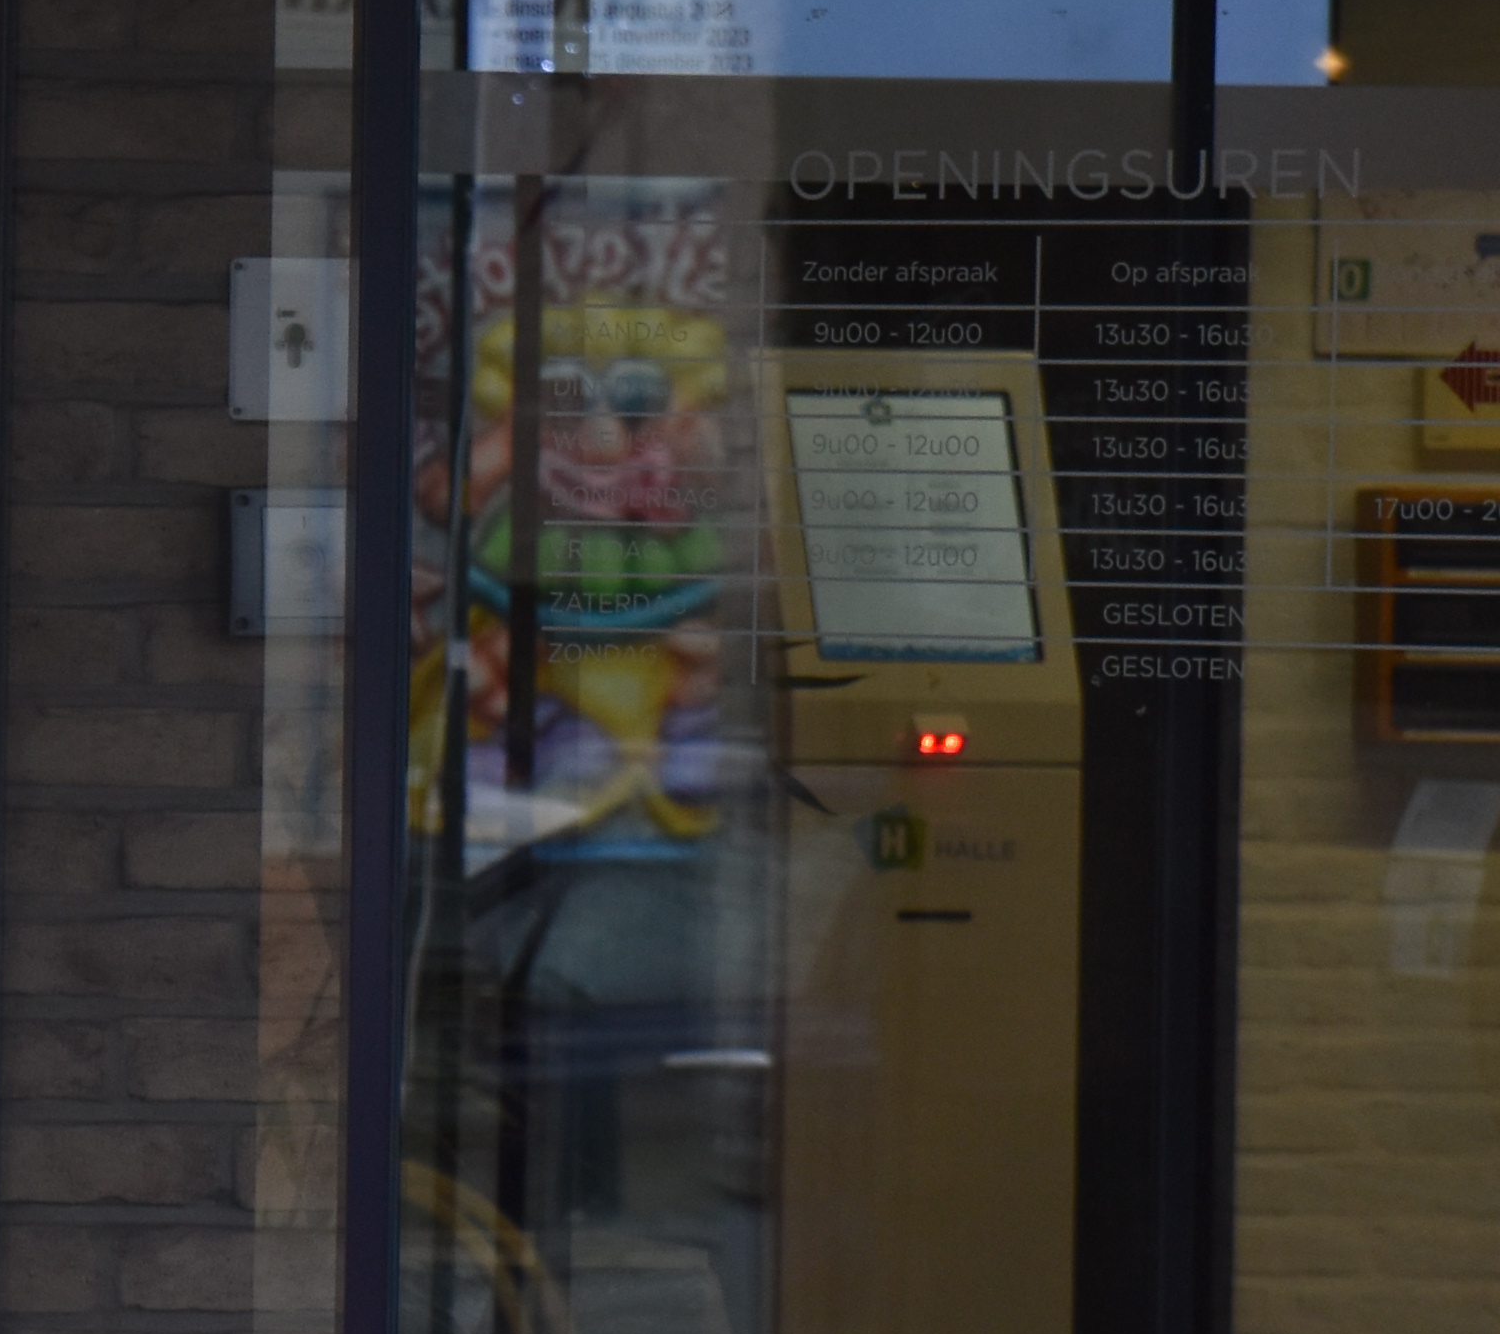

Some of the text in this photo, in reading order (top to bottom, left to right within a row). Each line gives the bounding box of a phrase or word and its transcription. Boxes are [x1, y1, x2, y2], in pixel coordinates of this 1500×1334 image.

[789, 148, 1362, 201] OPENINGSUREN
[801, 260, 999, 286] Zonder afspraak
[1111, 261, 1148, 287] Op
[813, 321, 881, 344] 9u00
[907, 321, 984, 345] 12u00
[1094, 323, 1171, 346] 13u30
[1093, 378, 1170, 402] 13u30
[811, 433, 879, 455] 9u00
[904, 433, 980, 457] 12u00
[1091, 436, 1168, 459] 13u30
[1194, 437, 1250, 460] 16u3
[550, 487, 718, 510] DONDERDAG
[810, 489, 878, 511] 9u00
[903, 490, 979, 513] 12u00
[1091, 493, 1167, 516] 13u30
[1193, 494, 1249, 517] 16u3
[1374, 498, 1454, 521] 17u00
[809, 543, 877, 565] 9u00
[902, 544, 978, 567] 12u00
[1090, 548, 1166, 571] 13u30
[1191, 550, 1249, 573] 16u3
[547, 590, 688, 616] ZATERDAG
[1102, 602, 1245, 627] GESLOTEN
[546, 642, 658, 666] ZONDAG
[1101, 655, 1245, 681] GESLOTEN
[934, 839, 1017, 861] HALLE
